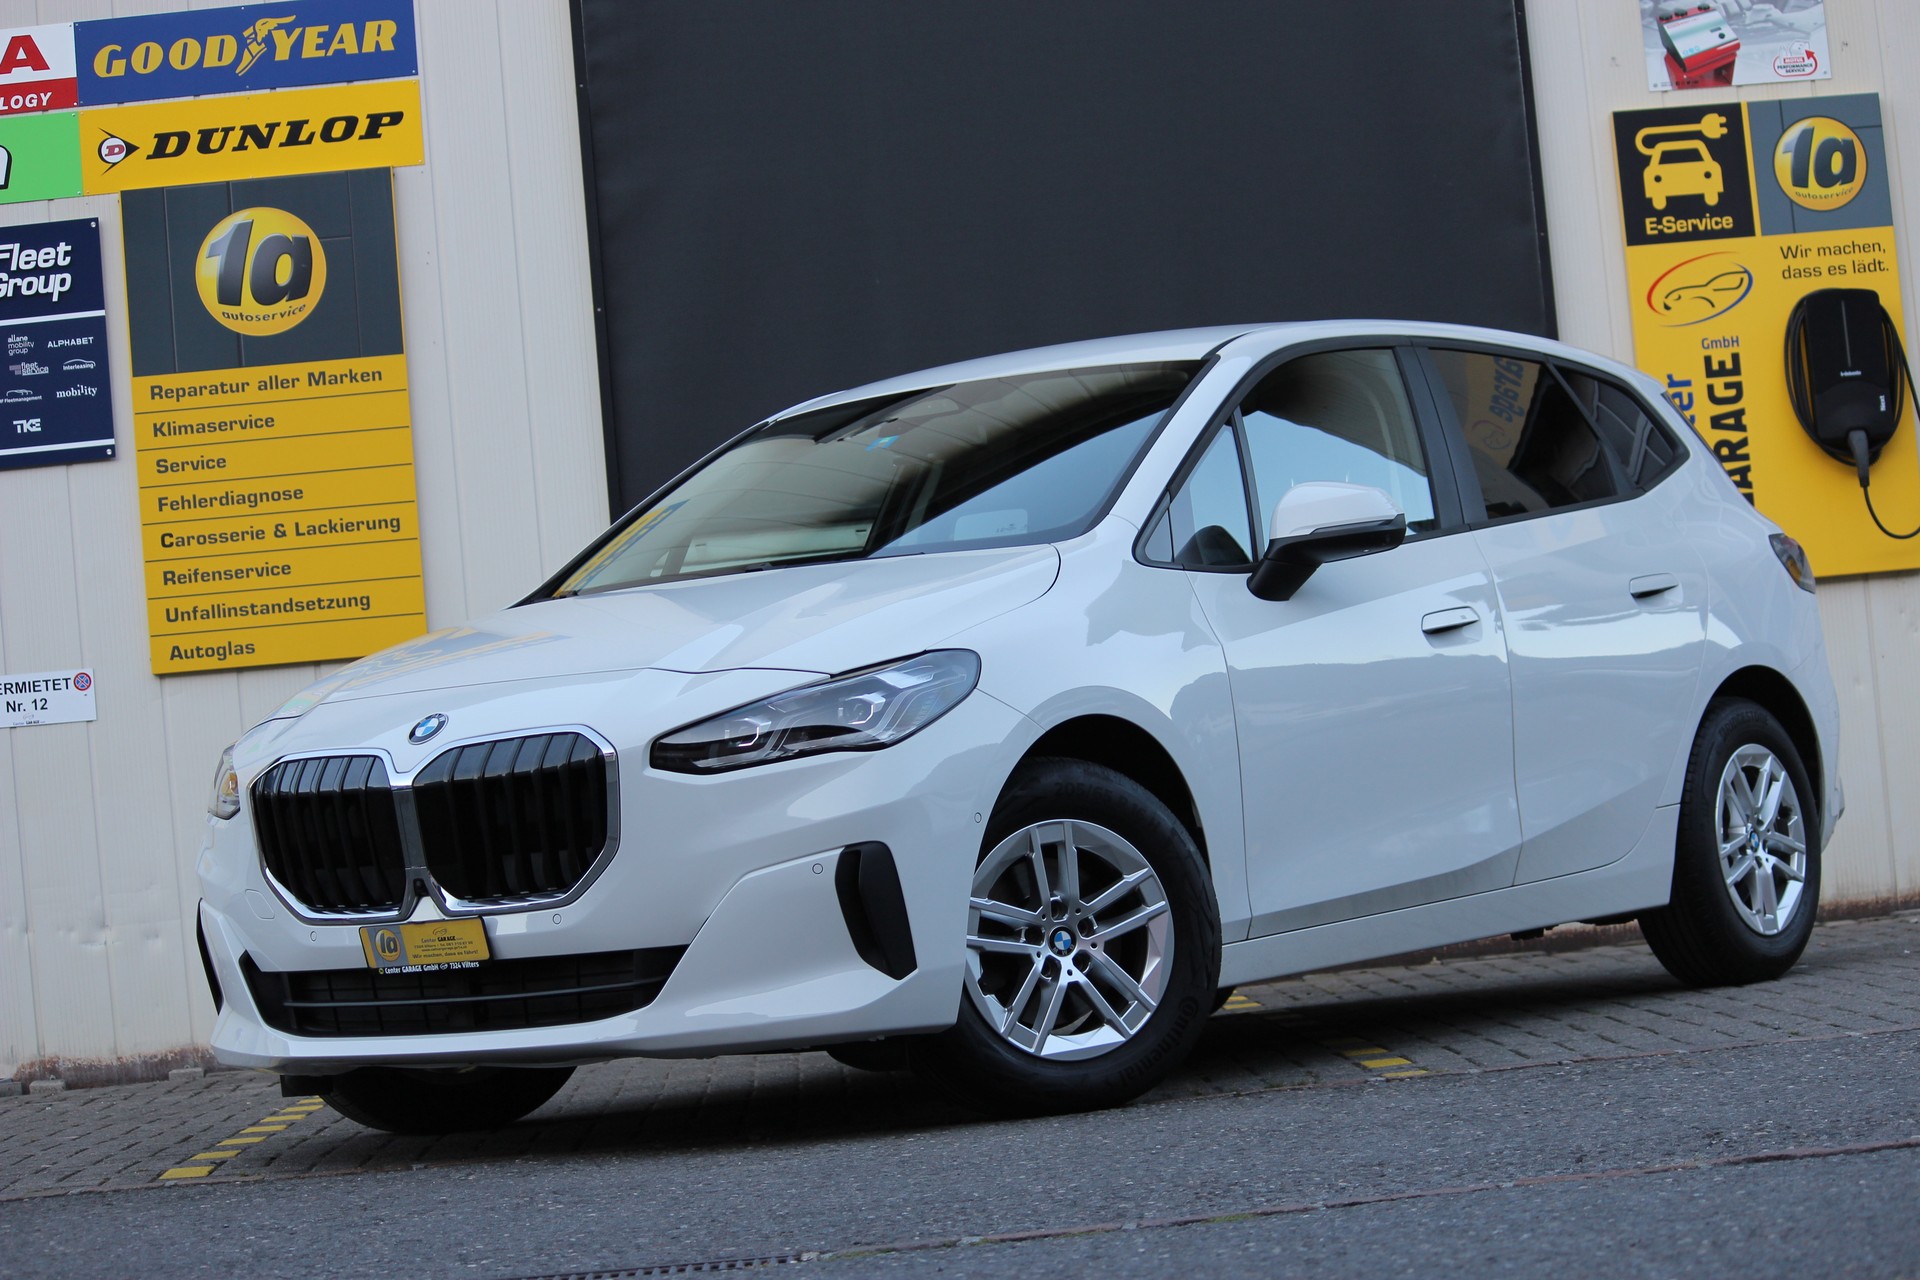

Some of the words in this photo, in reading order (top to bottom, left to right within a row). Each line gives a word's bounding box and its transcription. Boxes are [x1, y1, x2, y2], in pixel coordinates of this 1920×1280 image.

[146, 110, 404, 160] DUNLOP
[1782, 127, 1856, 189] 1a
[1645, 213, 1733, 235] E-Service
[1780, 245, 1812, 260] Wir
[1816, 240, 1886, 258] machen,
[205, 219, 313, 307] 1a
[1782, 265, 1824, 280] dass
[1827, 264, 1847, 277] es
[1852, 258, 1889, 274] lädt.
[221, 304, 306, 322] autoservice
[8, 341, 35, 349] mobility
[8, 348, 28, 356] group
[47, 337, 94, 348] ALPHABET
[1701, 336, 1740, 350] GmbH
[56, 384, 97, 398] mobility
[150, 379, 250, 402] Reparatur
[257, 374, 300, 391] aller
[307, 367, 382, 387] Marken
[153, 414, 275, 437] Klimaservice
[1703, 352, 1755, 508] ARAGE
[155, 455, 227, 474] Service
[157, 487, 304, 512] Fehlerdiagnose
[160, 525, 266, 548] Carosserie
[273, 523, 287, 538] &
[294, 516, 401, 538] Lackierung
[163, 562, 292, 586] Reifenservice
[165, 594, 371, 623] Unfallinstandsetzung
[169, 641, 255, 661] Autoglas
[0, 677, 71, 695] RMIETET
[6, 700, 26, 713] Nr.
[31, 698, 48, 711] 12
[401, 964, 423, 973] GARAGE
[423, 963, 439, 972] GmbH
